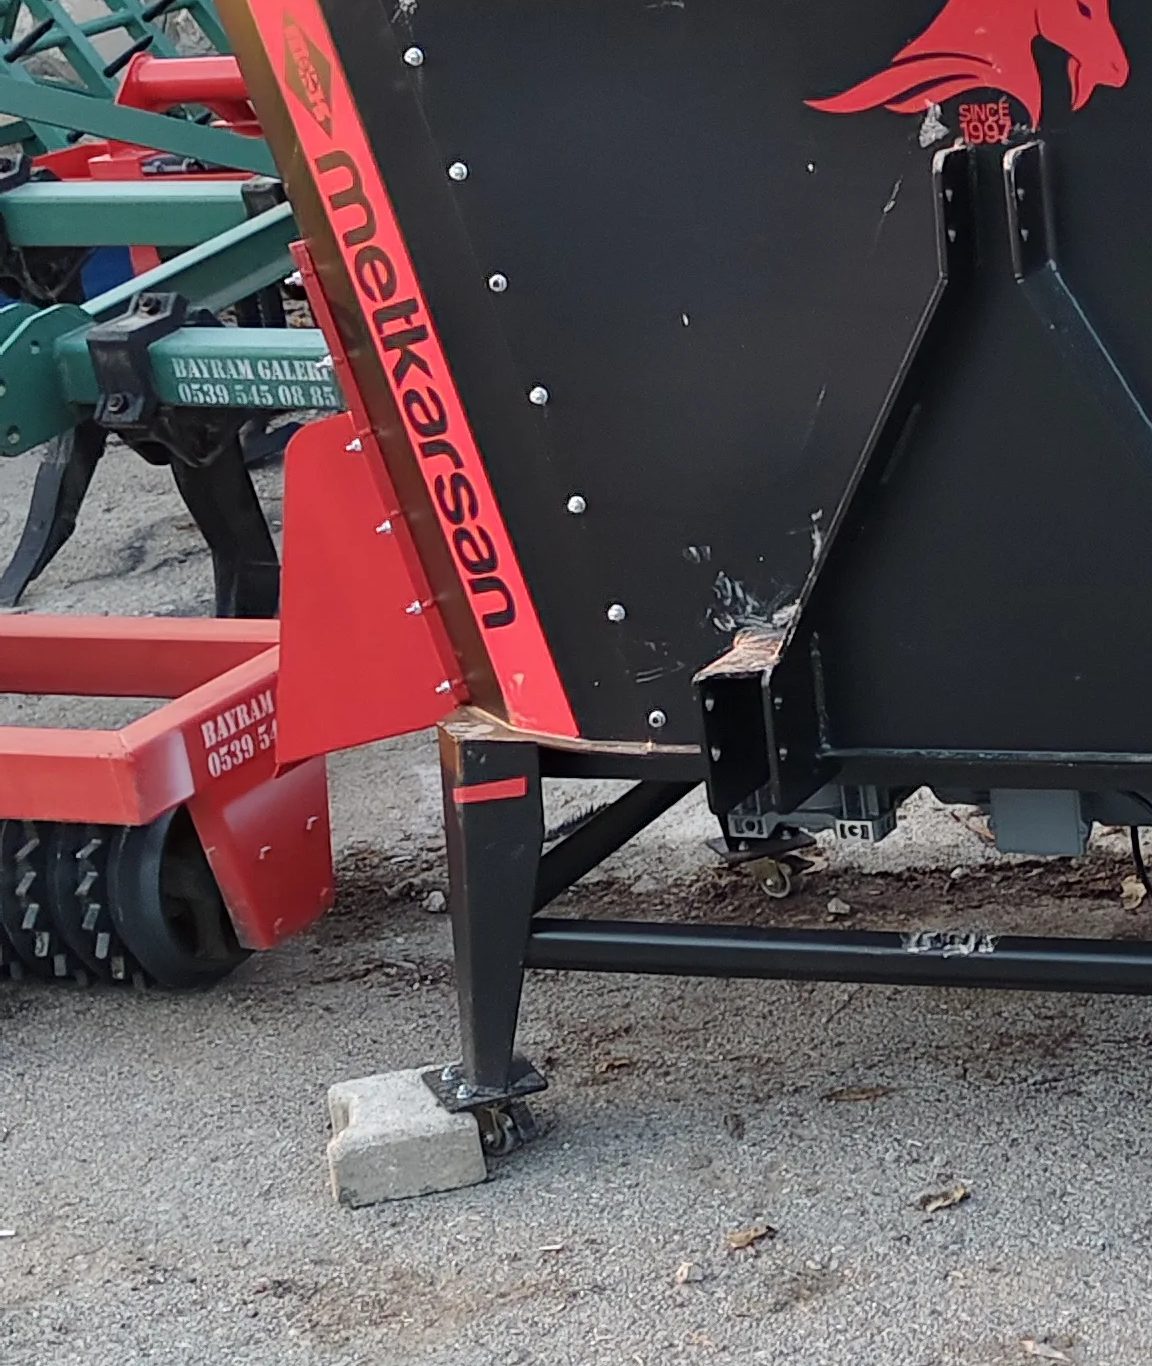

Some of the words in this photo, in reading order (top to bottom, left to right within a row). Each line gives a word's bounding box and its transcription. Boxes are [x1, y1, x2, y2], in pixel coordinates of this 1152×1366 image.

[959, 104, 1009, 121] SINCE
[960, 120, 1011, 145] 1997
[172, 357, 255, 380] BAYRAM
[178, 383, 230, 405] 0539
[235, 385, 274, 406] 545
[278, 386, 305, 407] 08
[310, 386, 338, 407] 85
[314, 149, 517, 630] metkarsan
[201, 690, 275, 749] BAYRAM
[208, 733, 254, 778] 0539
